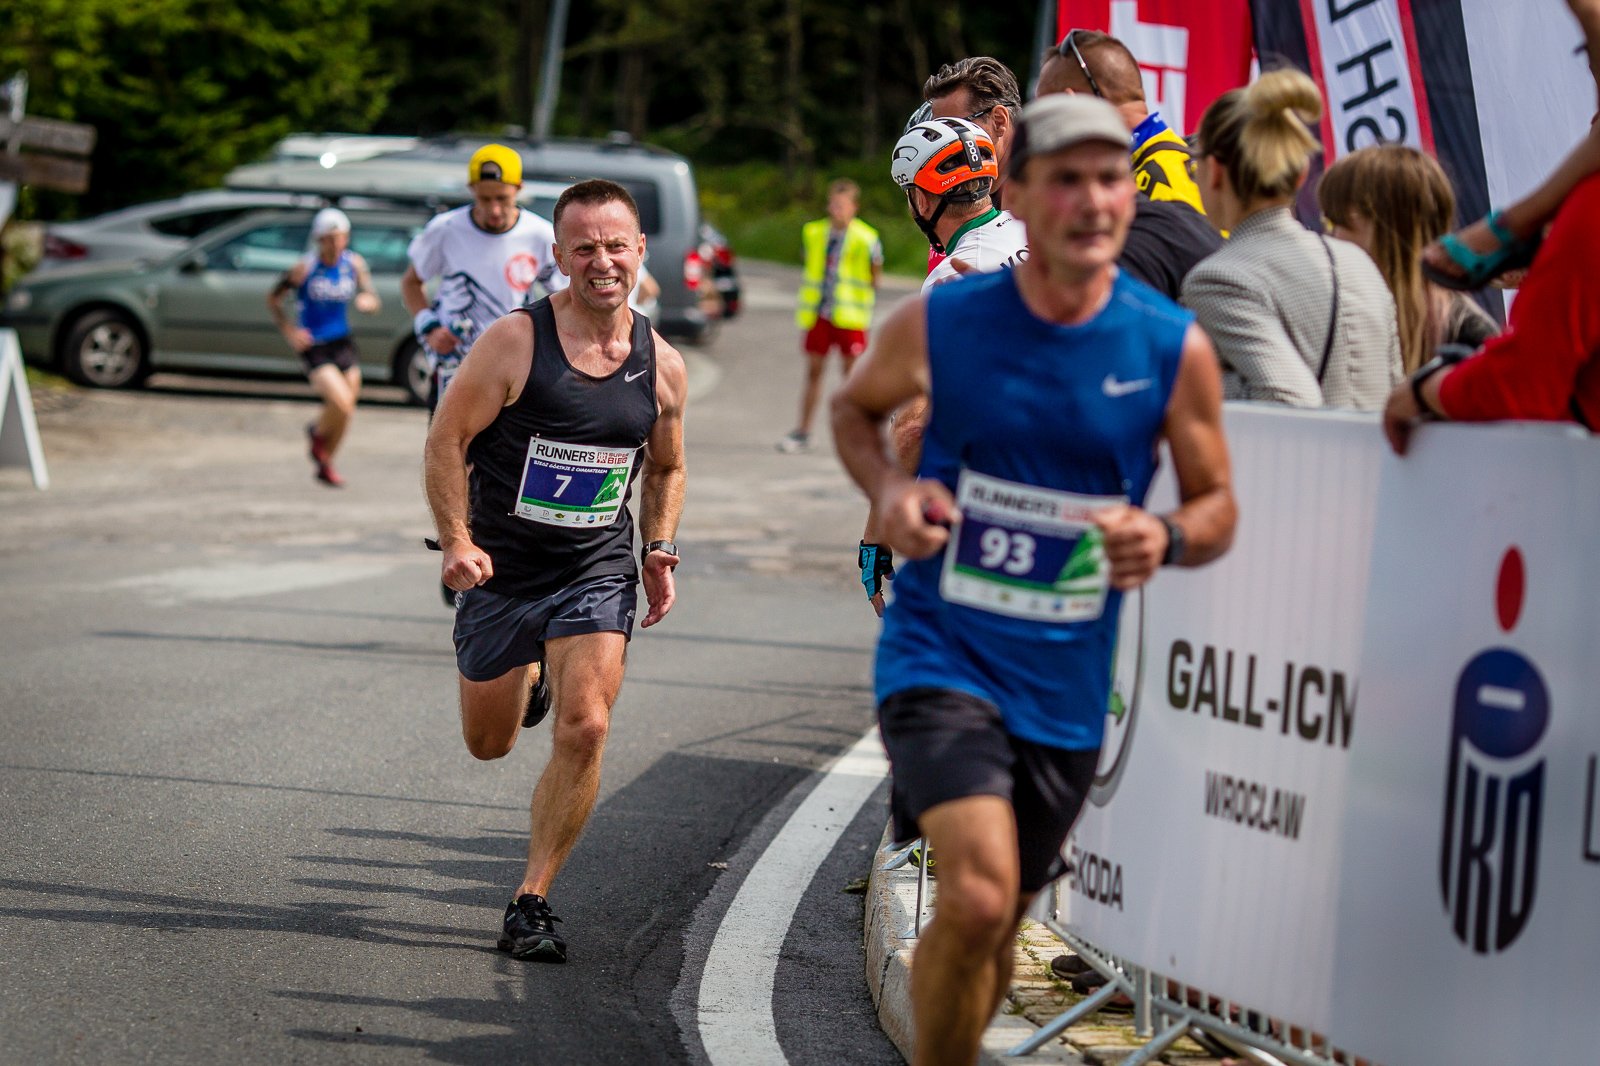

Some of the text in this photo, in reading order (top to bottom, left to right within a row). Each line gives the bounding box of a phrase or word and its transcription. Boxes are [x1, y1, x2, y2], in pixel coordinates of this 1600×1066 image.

[965, 140, 979, 162] POC
[536, 443, 596, 463] RUNNER'S
[607, 457, 628, 465] BIEG
[552, 474, 573, 498] 7
[979, 526, 1037, 576] 93
